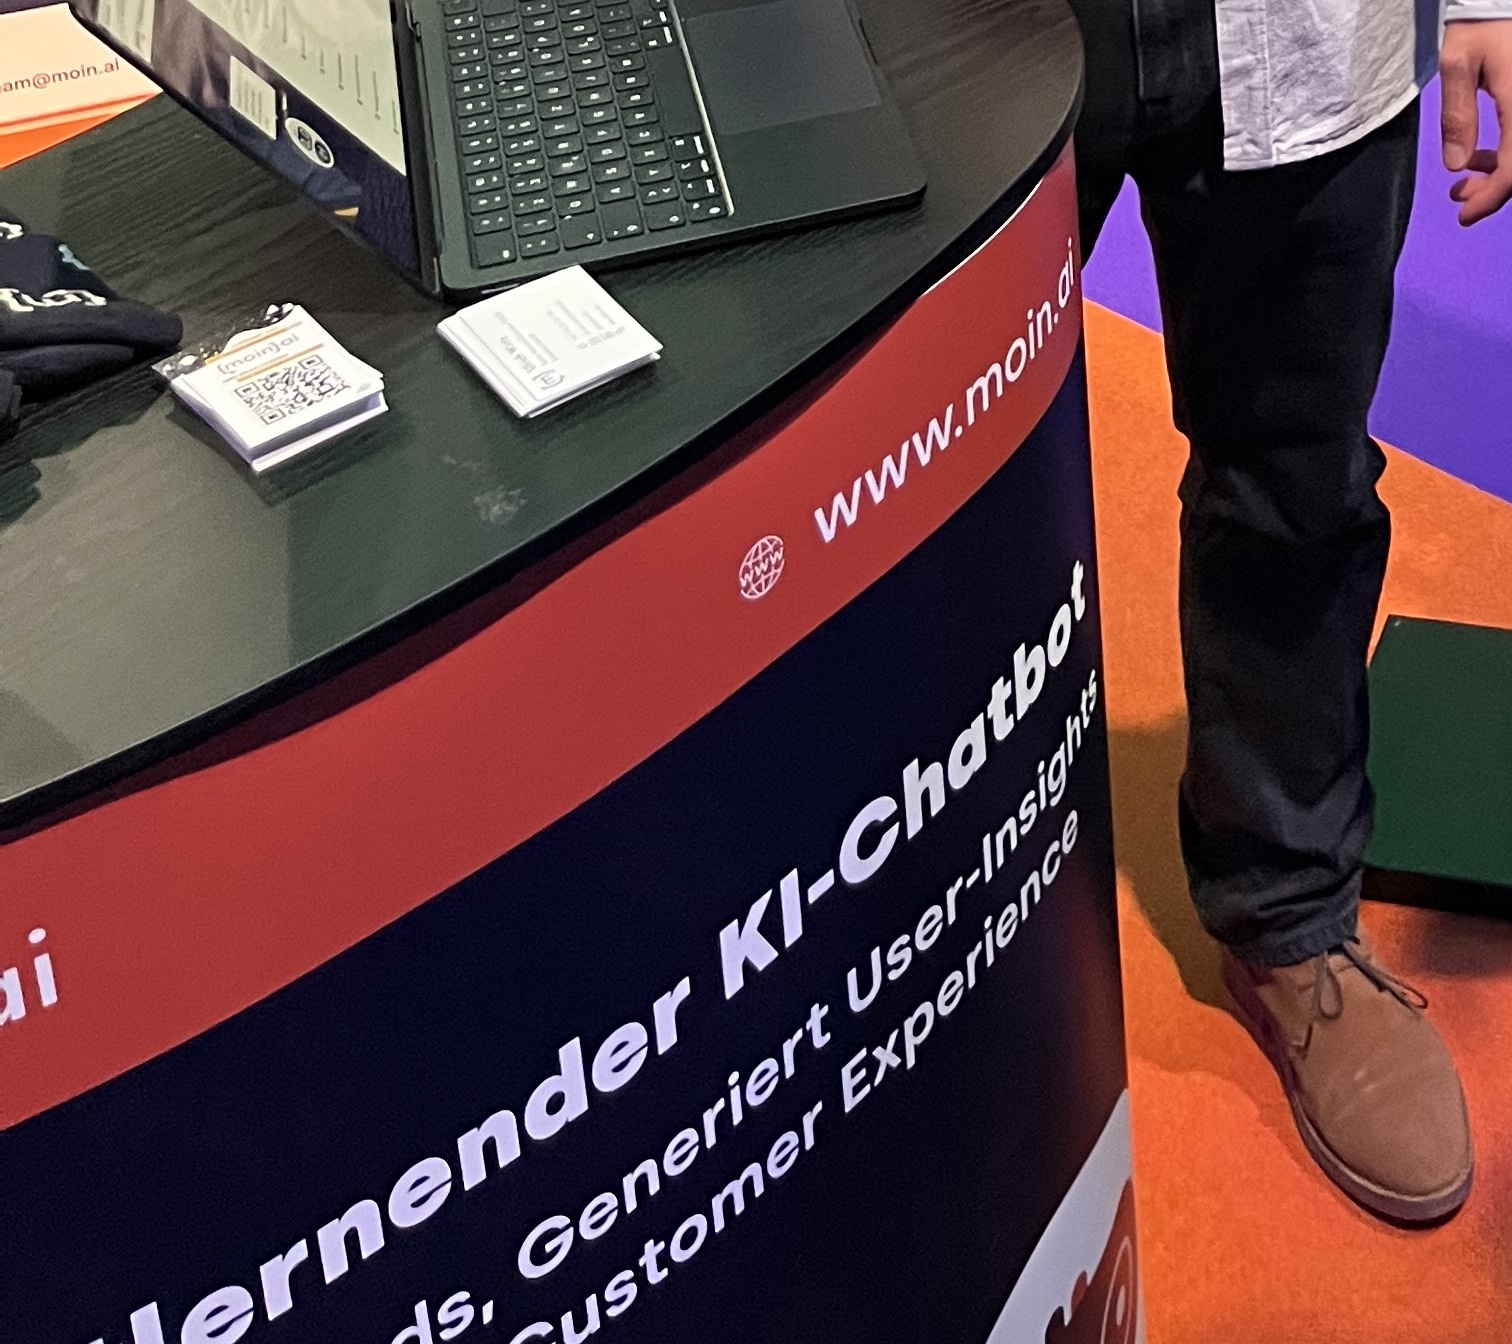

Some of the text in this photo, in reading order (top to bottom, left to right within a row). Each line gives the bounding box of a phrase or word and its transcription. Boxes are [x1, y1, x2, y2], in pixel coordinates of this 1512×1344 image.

[813, 237, 1075, 544] www.moin.ai
[718, 559, 1086, 1000] KI-Chatbot
[842, 806, 1079, 1117] Experience
[517, 1001, 833, 1279] Generiert
[846, 668, 1099, 1016] User-Insights
